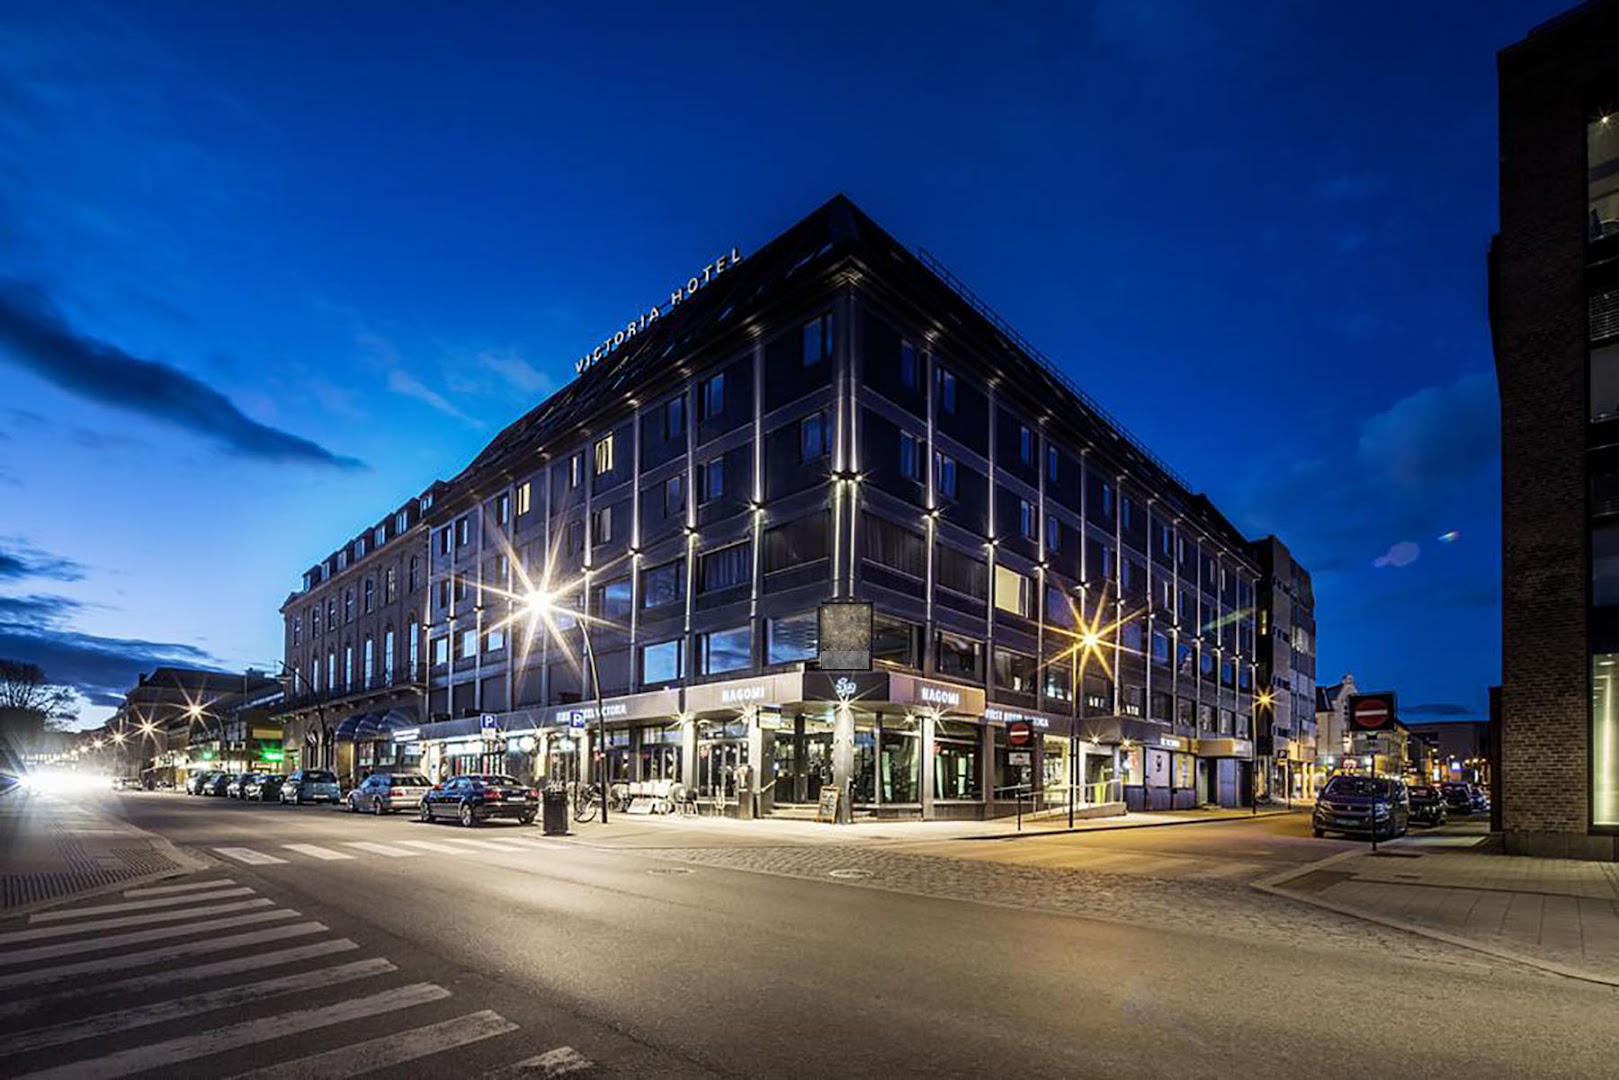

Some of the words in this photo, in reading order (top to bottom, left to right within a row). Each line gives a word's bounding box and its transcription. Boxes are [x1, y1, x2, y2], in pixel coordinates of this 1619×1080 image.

[574, 306, 660, 373] VICTORIA
[671, 248, 741, 305] HOTEL
[722, 686, 765, 702] NAGOMI
[921, 687, 960, 705] NAGOMI
[595, 704, 627, 718] VCTORIA
[573, 713, 582, 727] P
